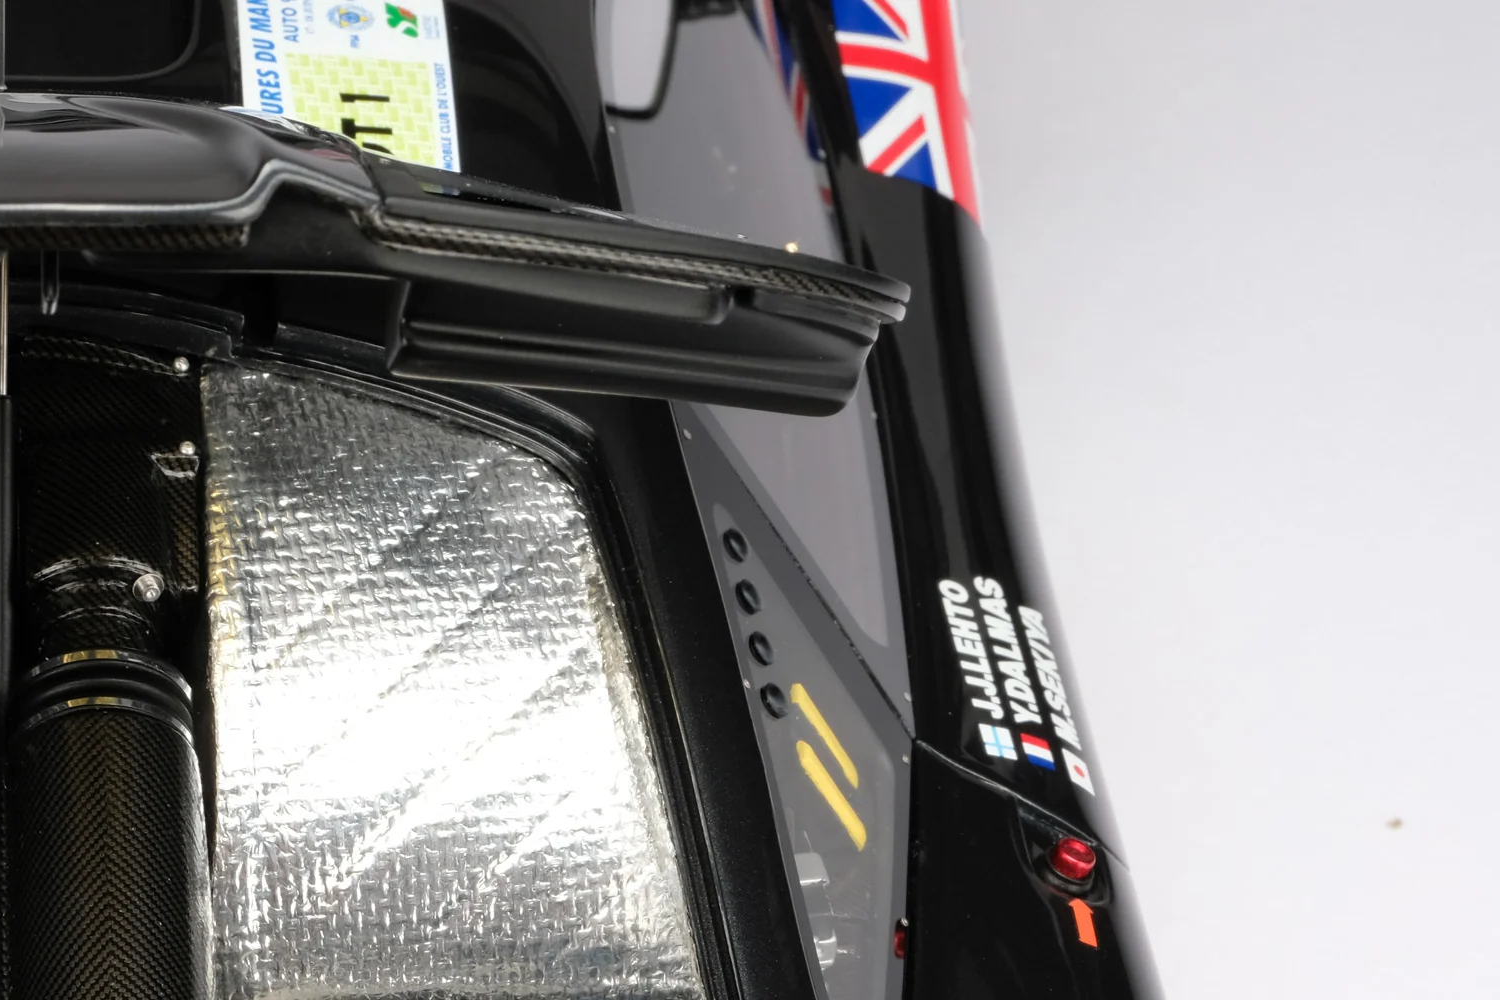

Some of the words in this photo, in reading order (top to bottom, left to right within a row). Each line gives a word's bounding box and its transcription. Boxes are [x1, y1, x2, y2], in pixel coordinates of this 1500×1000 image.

[246, 0, 274, 34] MAN
[280, 7, 300, 43] AUTO
[251, 38, 278, 63] DU
[256, 69, 284, 115] URES
[433, 62, 447, 96] L'OUEST
[437, 98, 449, 110] DE
[438, 112, 451, 134] CLUB
[440, 137, 454, 171] MOBILE
[937, 578, 1005, 720] J.J.LEHTO
[973, 575, 1043, 725] Y.DALMAS
[1017, 605, 1083, 751] M.SEKIYA
